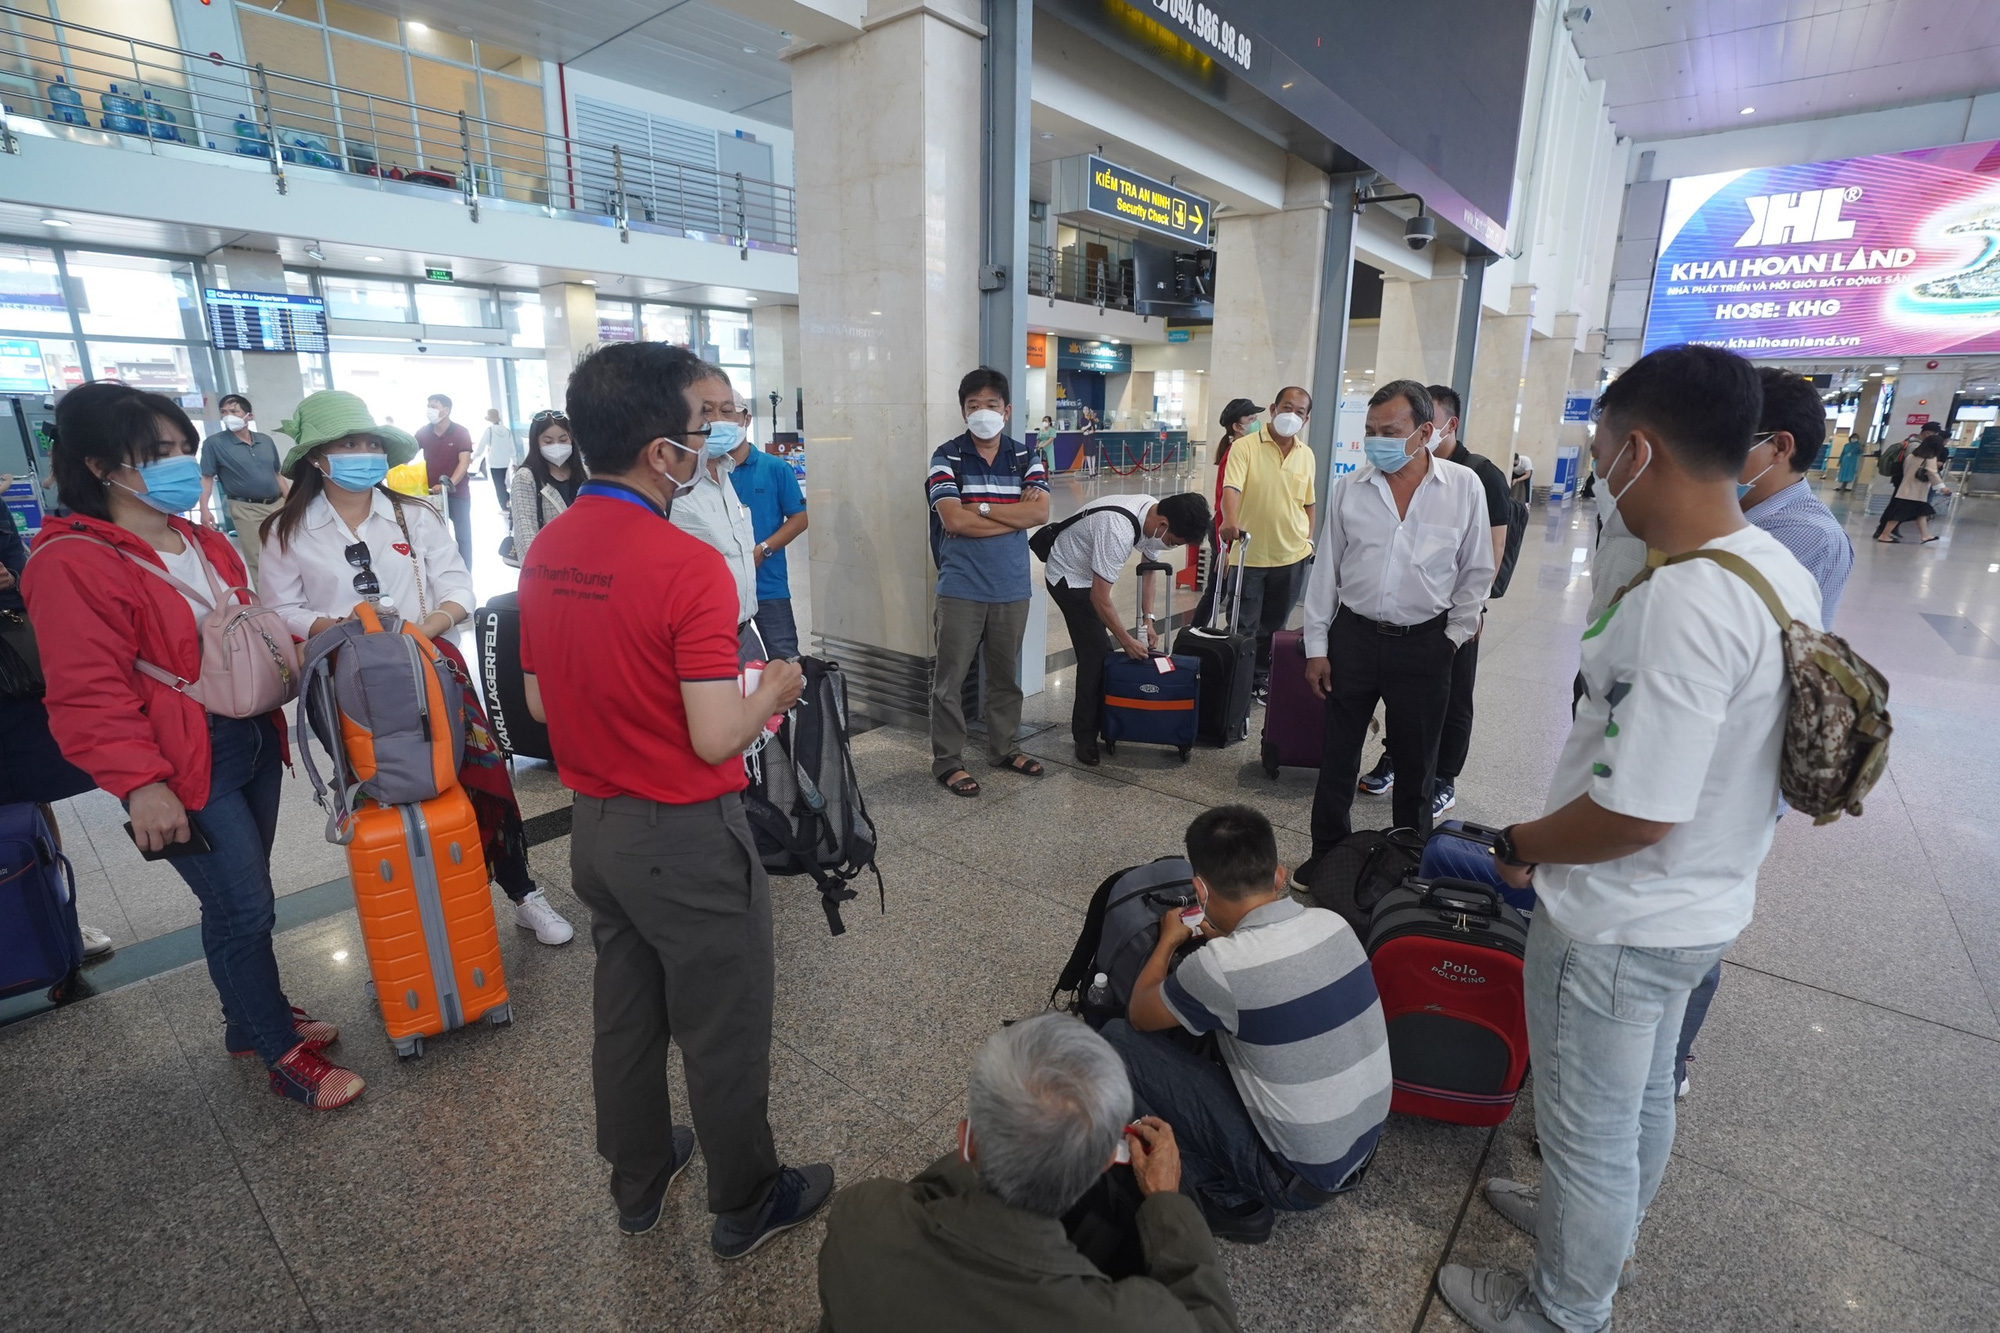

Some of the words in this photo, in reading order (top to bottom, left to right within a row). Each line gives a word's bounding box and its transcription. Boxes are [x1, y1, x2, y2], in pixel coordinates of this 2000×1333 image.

[1095, 168, 1118, 191] KIỂM
[1120, 180, 1137, 198] TRA
[1138, 187, 1150, 203] AN
[1152, 191, 1170, 210] NINH
[1116, 197, 1147, 221] Security
[1147, 208, 1169, 226] Check
[1670, 260, 1737, 281] KHAI
[1740, 254, 1828, 278] HOAN
[1831, 246, 1917, 272] LAND
[1667, 285, 1689, 295] NHÀ
[1692, 284, 1719, 294] PHÁT
[1753, 281, 1767, 291] VÀ
[1818, 276, 1844, 288] BẤT
[1846, 275, 1882, 287] ĐỘNG
[1715, 302, 1780, 320] HOSE:
[1787, 299, 1841, 318] KHG
[485, 612, 502, 710] LAGERFELD
[493, 711, 514, 751] KARL
[1431, 966, 1458, 981] POLO
[1442, 960, 1478, 976] Polo
